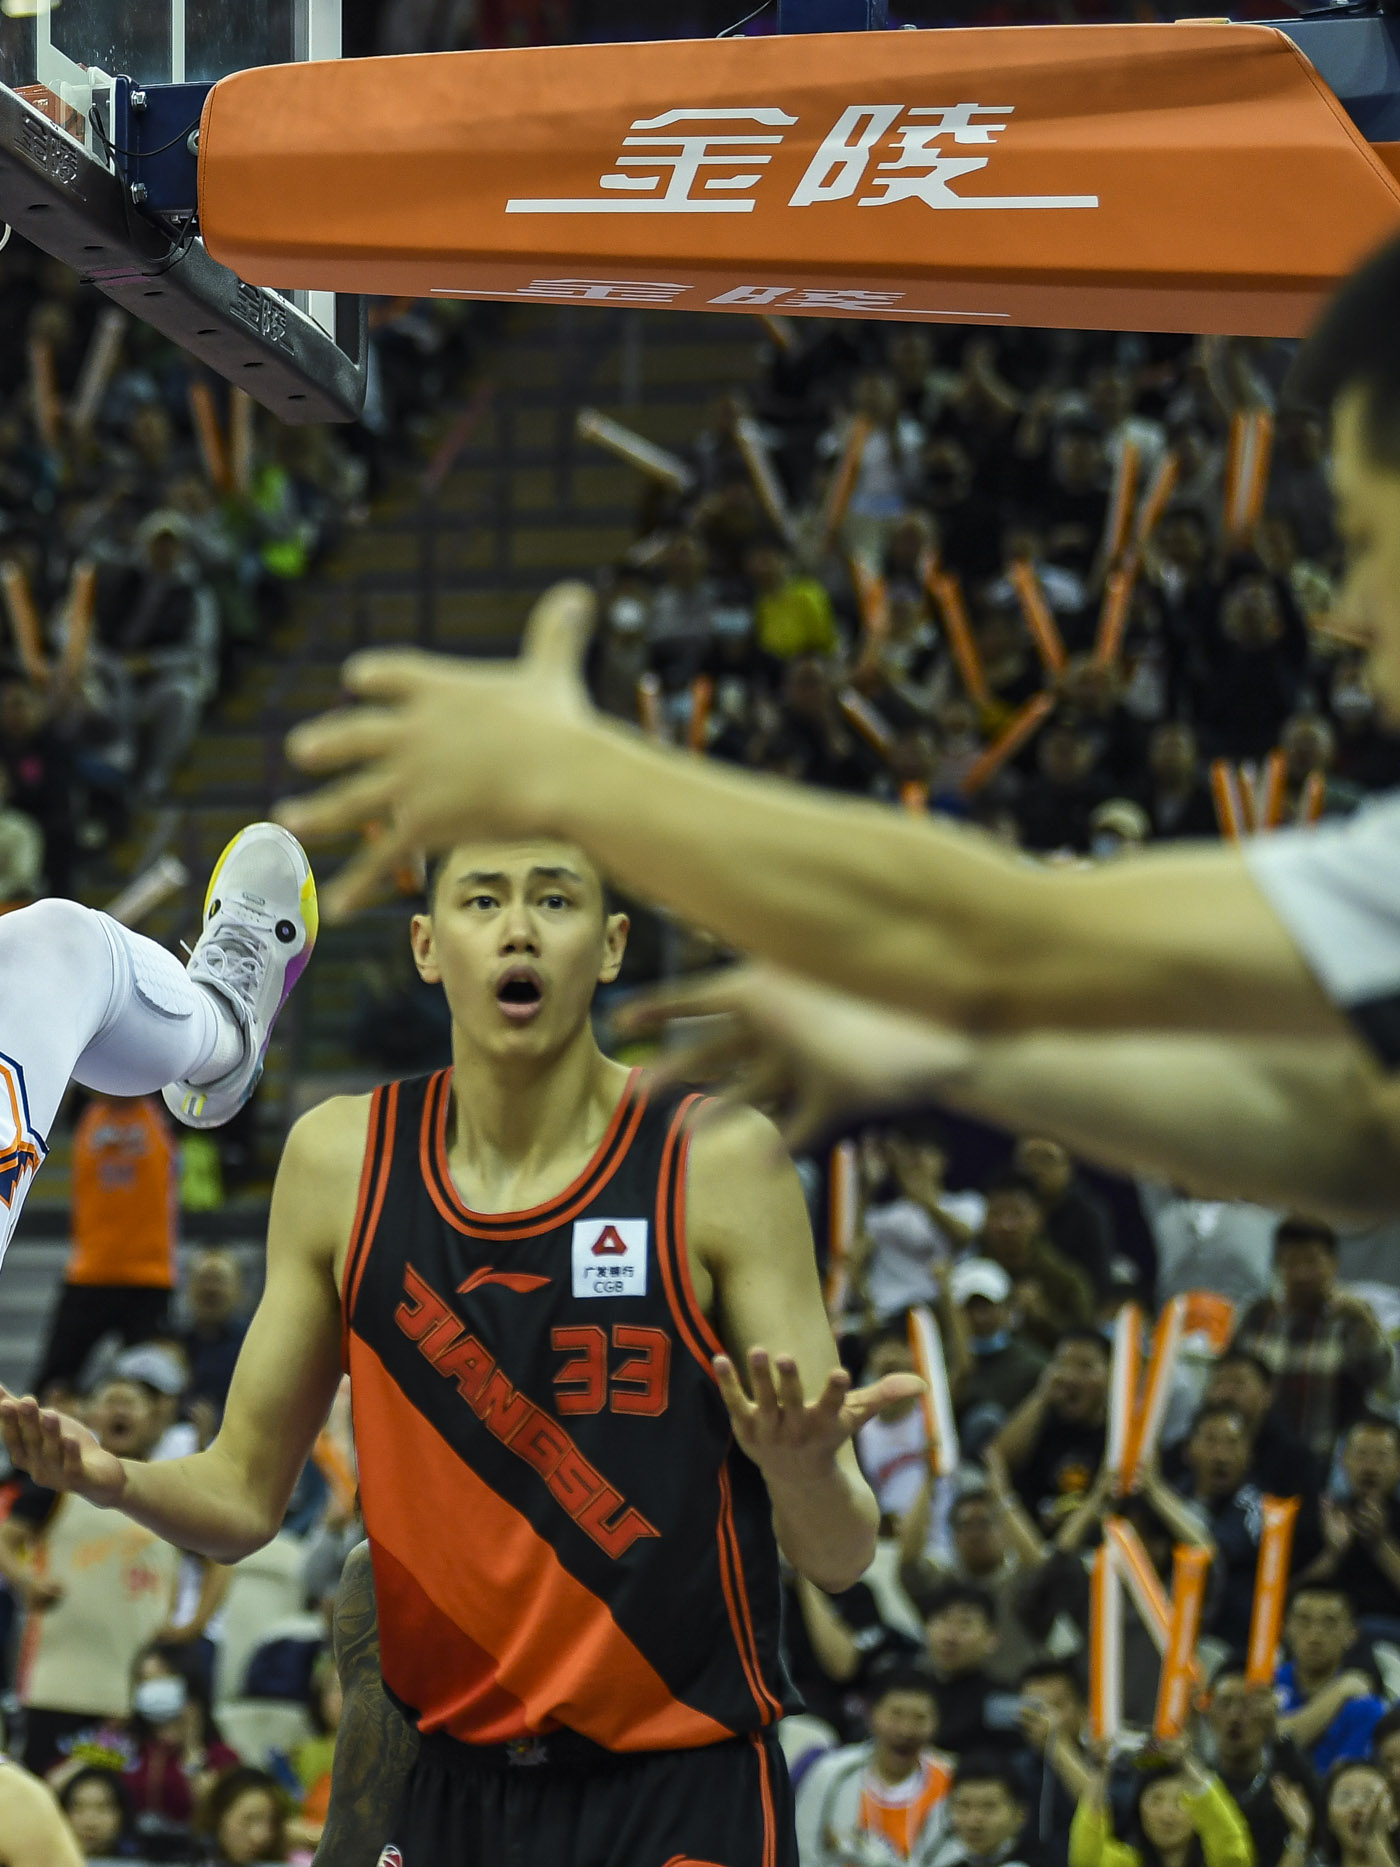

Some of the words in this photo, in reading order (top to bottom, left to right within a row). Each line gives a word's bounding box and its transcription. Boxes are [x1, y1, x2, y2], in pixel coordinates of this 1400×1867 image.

[505, 101, 1099, 214] 金陵
[428, 277, 1012, 318] 金陵
[593, 1281, 624, 1293] CGB
[393, 1261, 662, 1561] JIANGSU
[550, 1324, 671, 1417] 33
